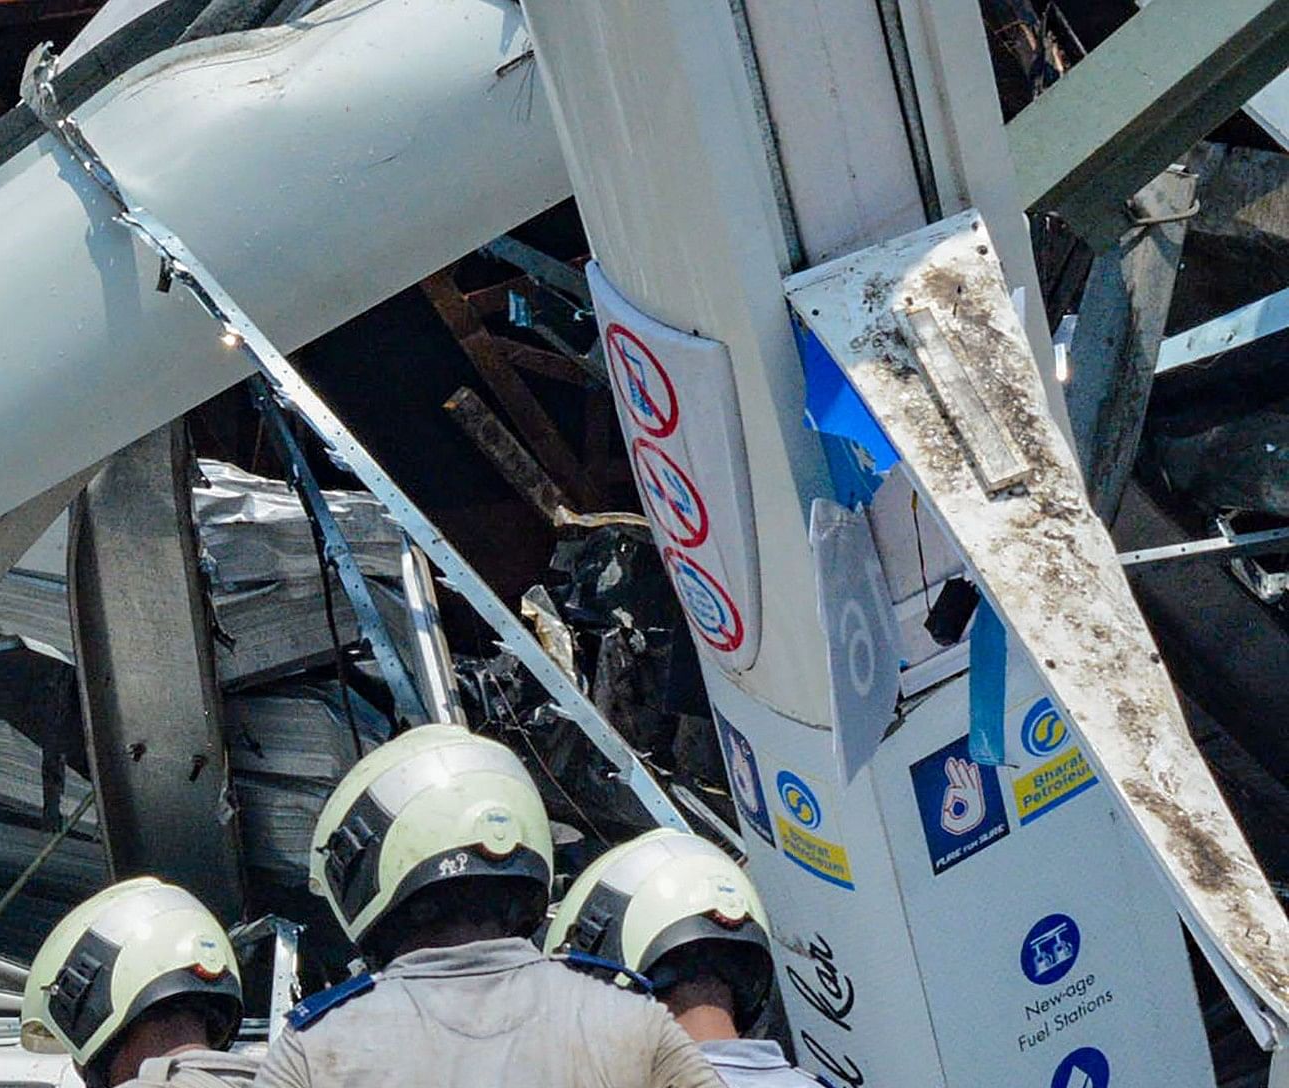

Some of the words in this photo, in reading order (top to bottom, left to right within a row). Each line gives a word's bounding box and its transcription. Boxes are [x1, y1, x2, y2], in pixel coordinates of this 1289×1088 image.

[1032, 751, 1086, 789] Bharat
[786, 931, 855, 1031] kar
[1025, 974, 1096, 1021] New-age
[1018, 1020, 1052, 1052] Fuel
[1055, 989, 1115, 1035] Stations
